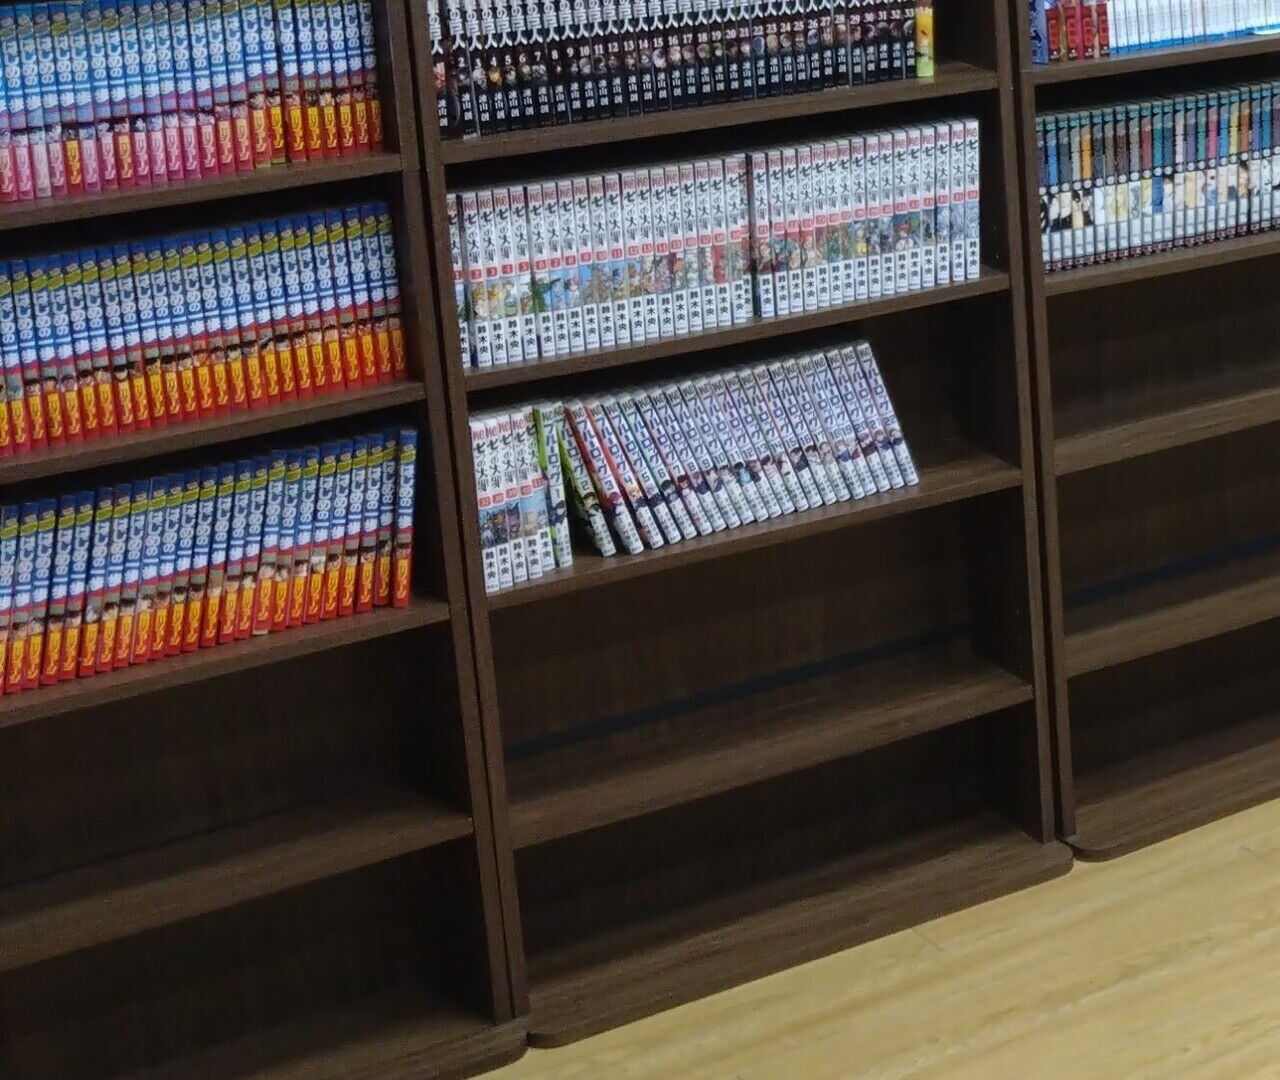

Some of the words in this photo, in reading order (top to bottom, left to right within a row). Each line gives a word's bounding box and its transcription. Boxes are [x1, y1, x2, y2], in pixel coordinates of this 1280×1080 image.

[878, 11, 886, 20] 31
[890, 9, 900, 19] 32
[905, 8, 914, 18] 33
[808, 19, 818, 28] 26
[851, 15, 860, 24] 29
[726, 29, 736, 38] 20
[753, 25, 763, 35] 22
[767, 24, 777, 33] 23
[682, 34, 692, 43] 17
[698, 32, 708, 42] 18
[712, 31, 721, 40] 19
[623, 41, 634, 51] 13
[654, 38, 663, 47] 15
[863, 359, 890, 411] ブルーロック
[833, 366, 862, 418] ブルーロック
[790, 374, 820, 428] ブルーロック
[762, 381, 791, 434] ブルーロック
[884, 416, 896, 425] 22
[842, 425, 852, 436] 19
[785, 435, 797, 447] 15
[801, 435, 812, 446] 16
[814, 431, 825, 443] 17
[743, 449, 756, 459] 12
[756, 444, 768, 455] 13
[703, 460, 711, 469] 9
[715, 455, 726, 466] 10
[688, 462, 696, 473] 8
[658, 469, 666, 479] 6
[624, 474, 634, 485] 4
[642, 474, 650, 486] 5
[580, 479, 589, 491] 2
[605, 479, 613, 491] 3
[555, 487, 561, 499] 1
